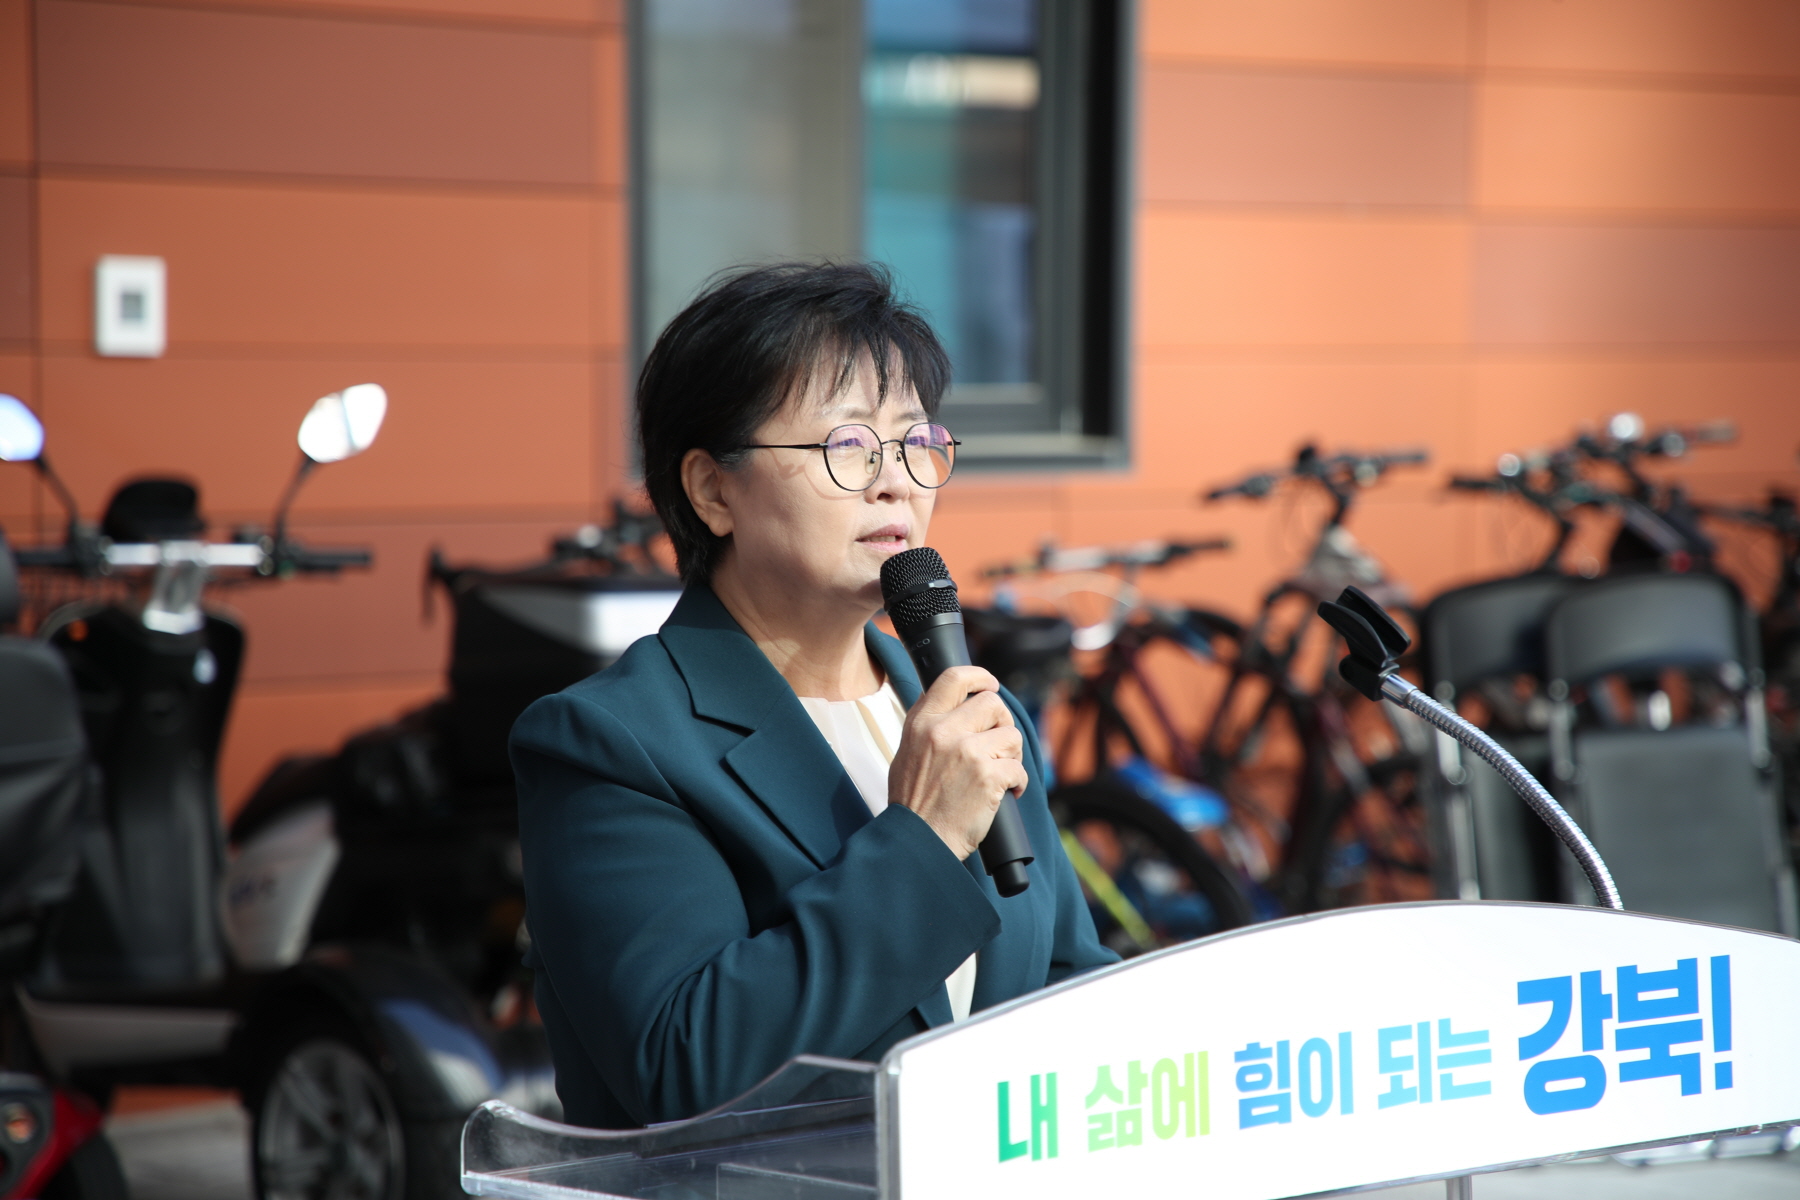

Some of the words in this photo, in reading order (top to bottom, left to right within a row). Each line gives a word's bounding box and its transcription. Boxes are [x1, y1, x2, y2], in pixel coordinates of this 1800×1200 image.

[997, 1072, 1059, 1163] 내
[1085, 1050, 1210, 1152] 삶에
[1234, 1031, 1354, 1130] 힘이
[1378, 1018, 1492, 1110] 되는
[1517, 954, 1733, 1115] 강북!
